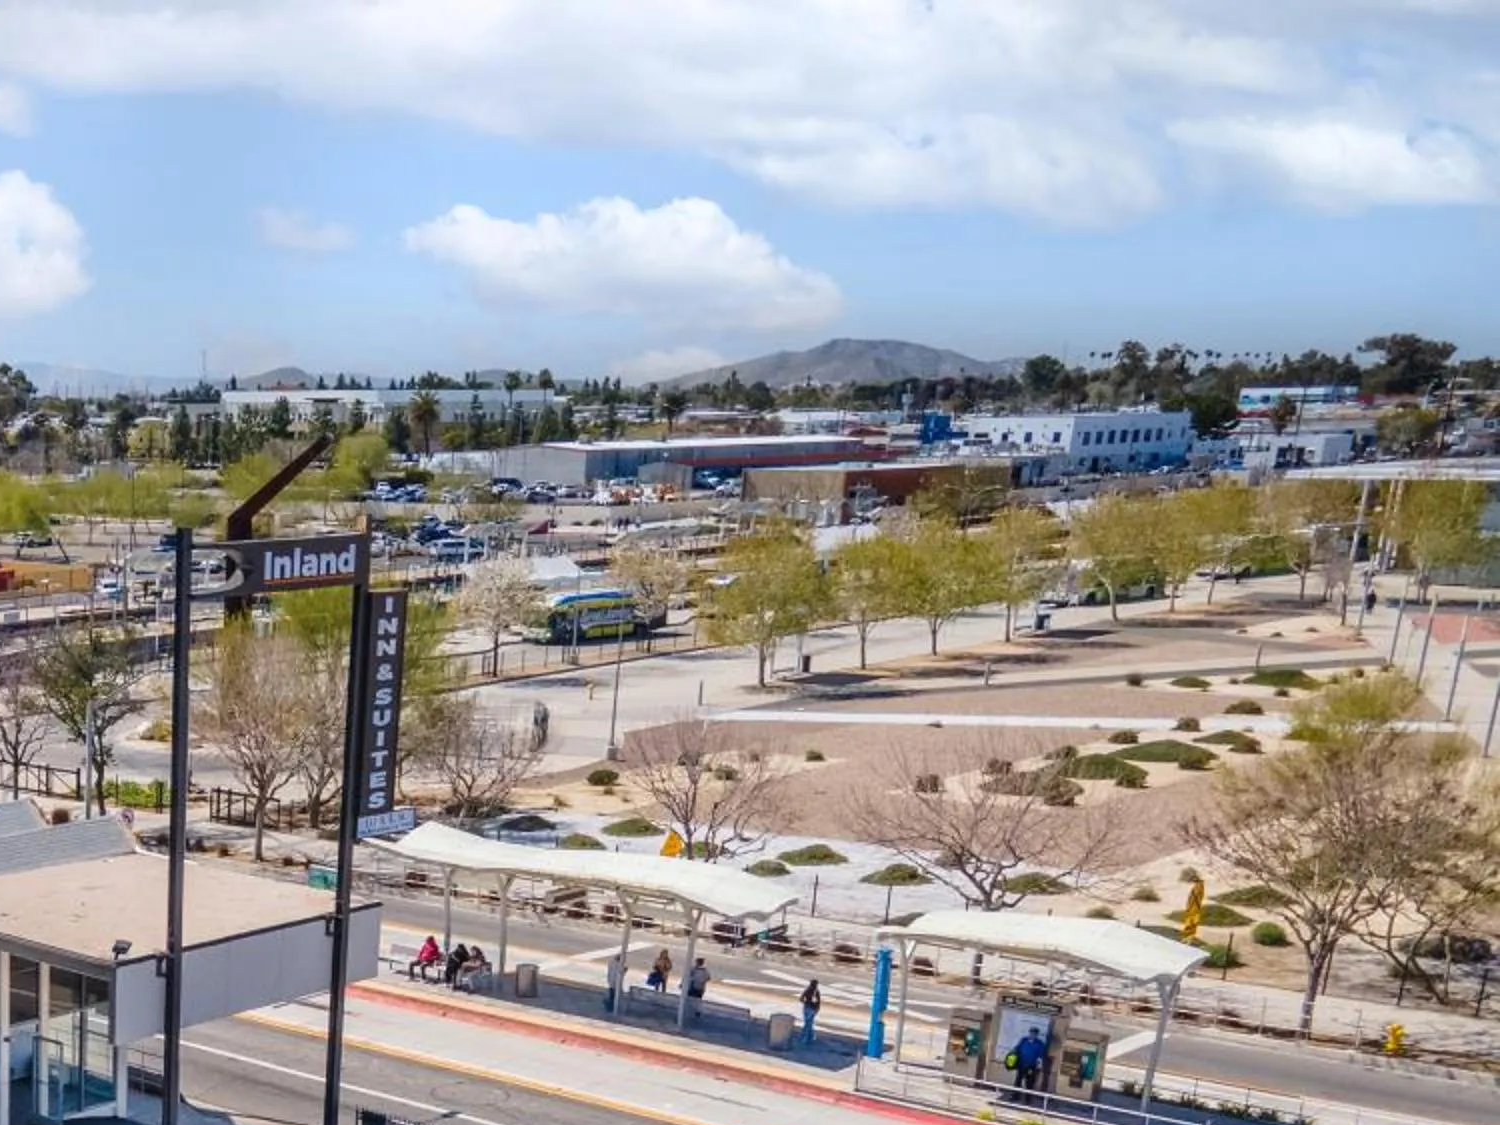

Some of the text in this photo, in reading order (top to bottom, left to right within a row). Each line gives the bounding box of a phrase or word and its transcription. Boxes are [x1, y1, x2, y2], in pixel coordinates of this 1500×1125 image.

[264, 545, 356, 580] Inland
[368, 596, 398, 809] INN & SUITES
